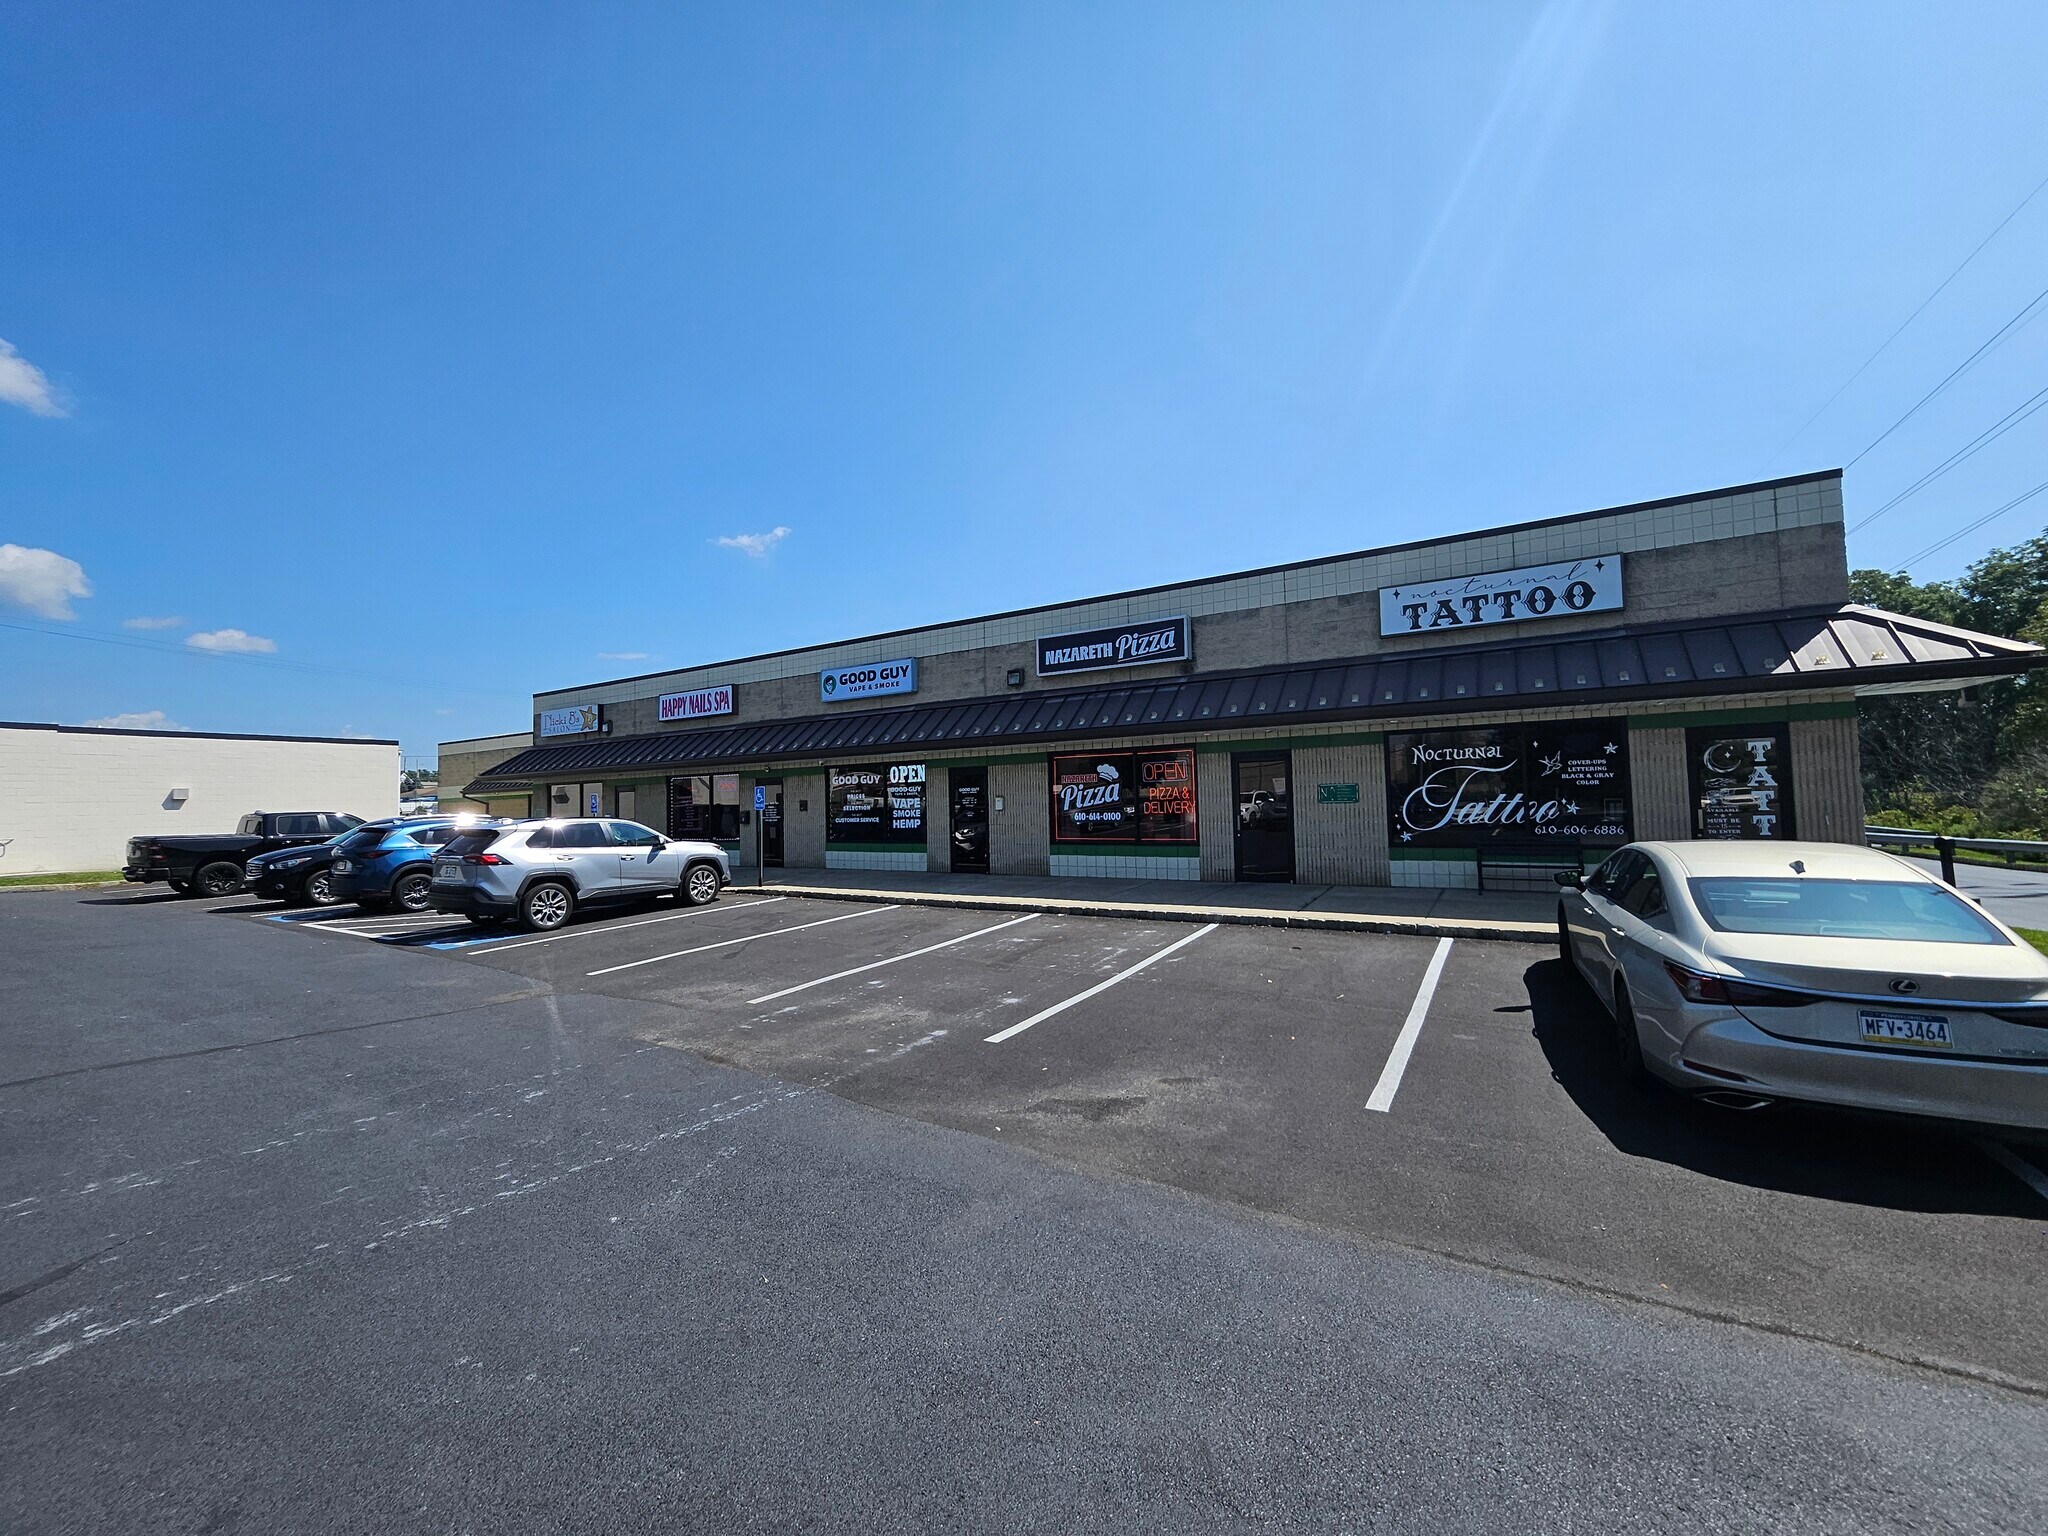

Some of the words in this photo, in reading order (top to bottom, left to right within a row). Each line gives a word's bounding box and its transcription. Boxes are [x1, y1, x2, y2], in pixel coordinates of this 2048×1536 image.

[1411, 562, 1587, 599] nocturnal
[1402, 580, 1597, 630] TATTOO
[1045, 642, 1113, 665] NAZARETH
[1115, 630, 1175, 660] Pizza
[839, 669, 877, 685] GOOD
[880, 665, 909, 680] GUY
[875, 681, 900, 690] SMOKE
[661, 696, 687, 718] HAPPY
[689, 692, 712, 714] NAILS
[714, 690, 730, 711] SPA
[890, 764, 925, 783] OPEN
[1061, 774, 1098, 783] NAZARETH
[1144, 762, 1186, 780] OPEN
[832, 776, 859, 784] GOOD
[860, 775, 880, 784] GUY
[1061, 783, 1120, 811] Pizza
[1149, 788, 1180, 800] PIZZA
[1182, 786, 1190, 799] &
[1403, 759, 1560, 831] Tattoo
[893, 798, 921, 808] VAPE
[1143, 800, 1196, 815] DELIVERY
[893, 809, 921, 817] SMOKE
[1074, 812, 1121, 821] 610-614-0100
[893, 819, 921, 828] HEMP
[1535, 825, 1624, 835] 610-606-6886
